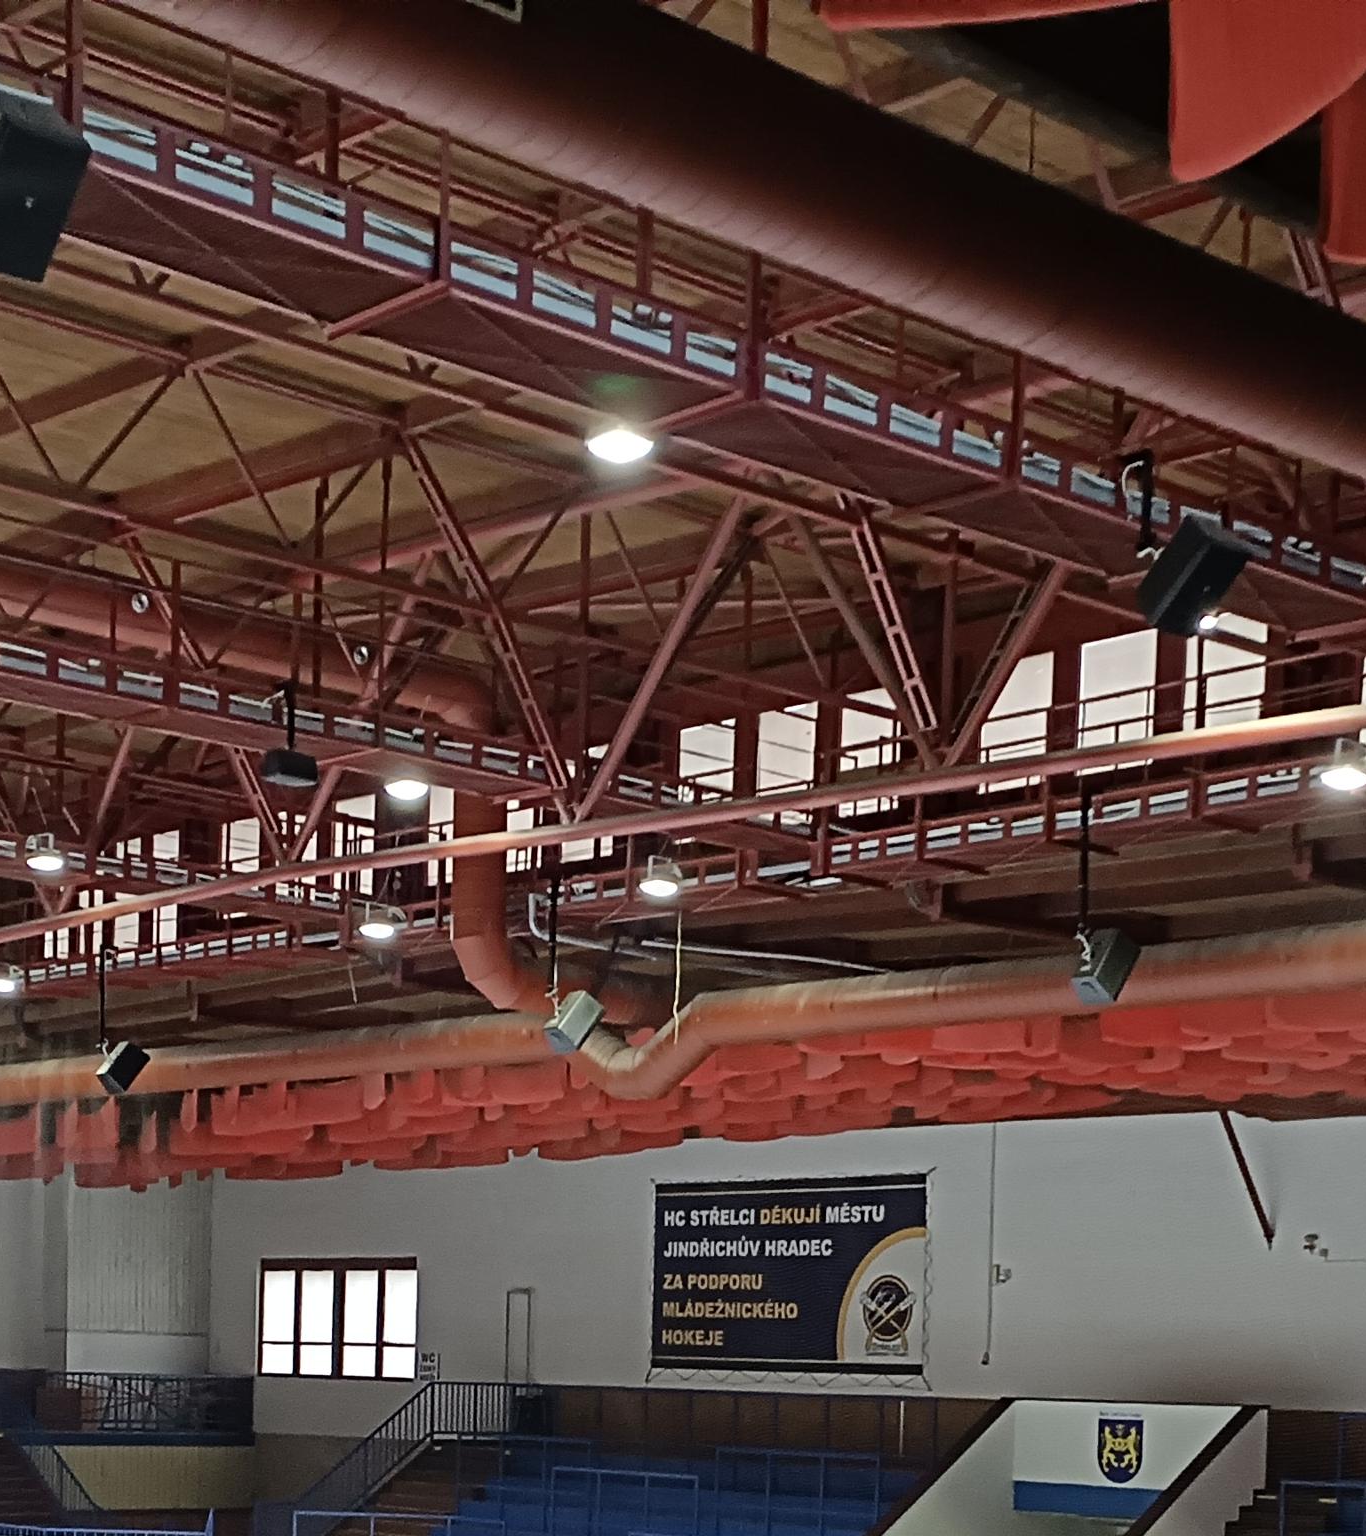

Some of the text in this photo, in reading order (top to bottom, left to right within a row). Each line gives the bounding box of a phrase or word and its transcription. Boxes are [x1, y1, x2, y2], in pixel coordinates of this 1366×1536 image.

[663, 1202, 885, 1227] HC STŘELCI DĚKUJÍ MĚSTU
[663, 1235, 833, 1258] JINDŘICHŮV HRADEC
[662, 1273, 764, 1290] ZA PODPORU
[662, 1297, 798, 1319] MLÁDEŽNICKÉHO
[661, 1328, 724, 1346] HOKEJE
